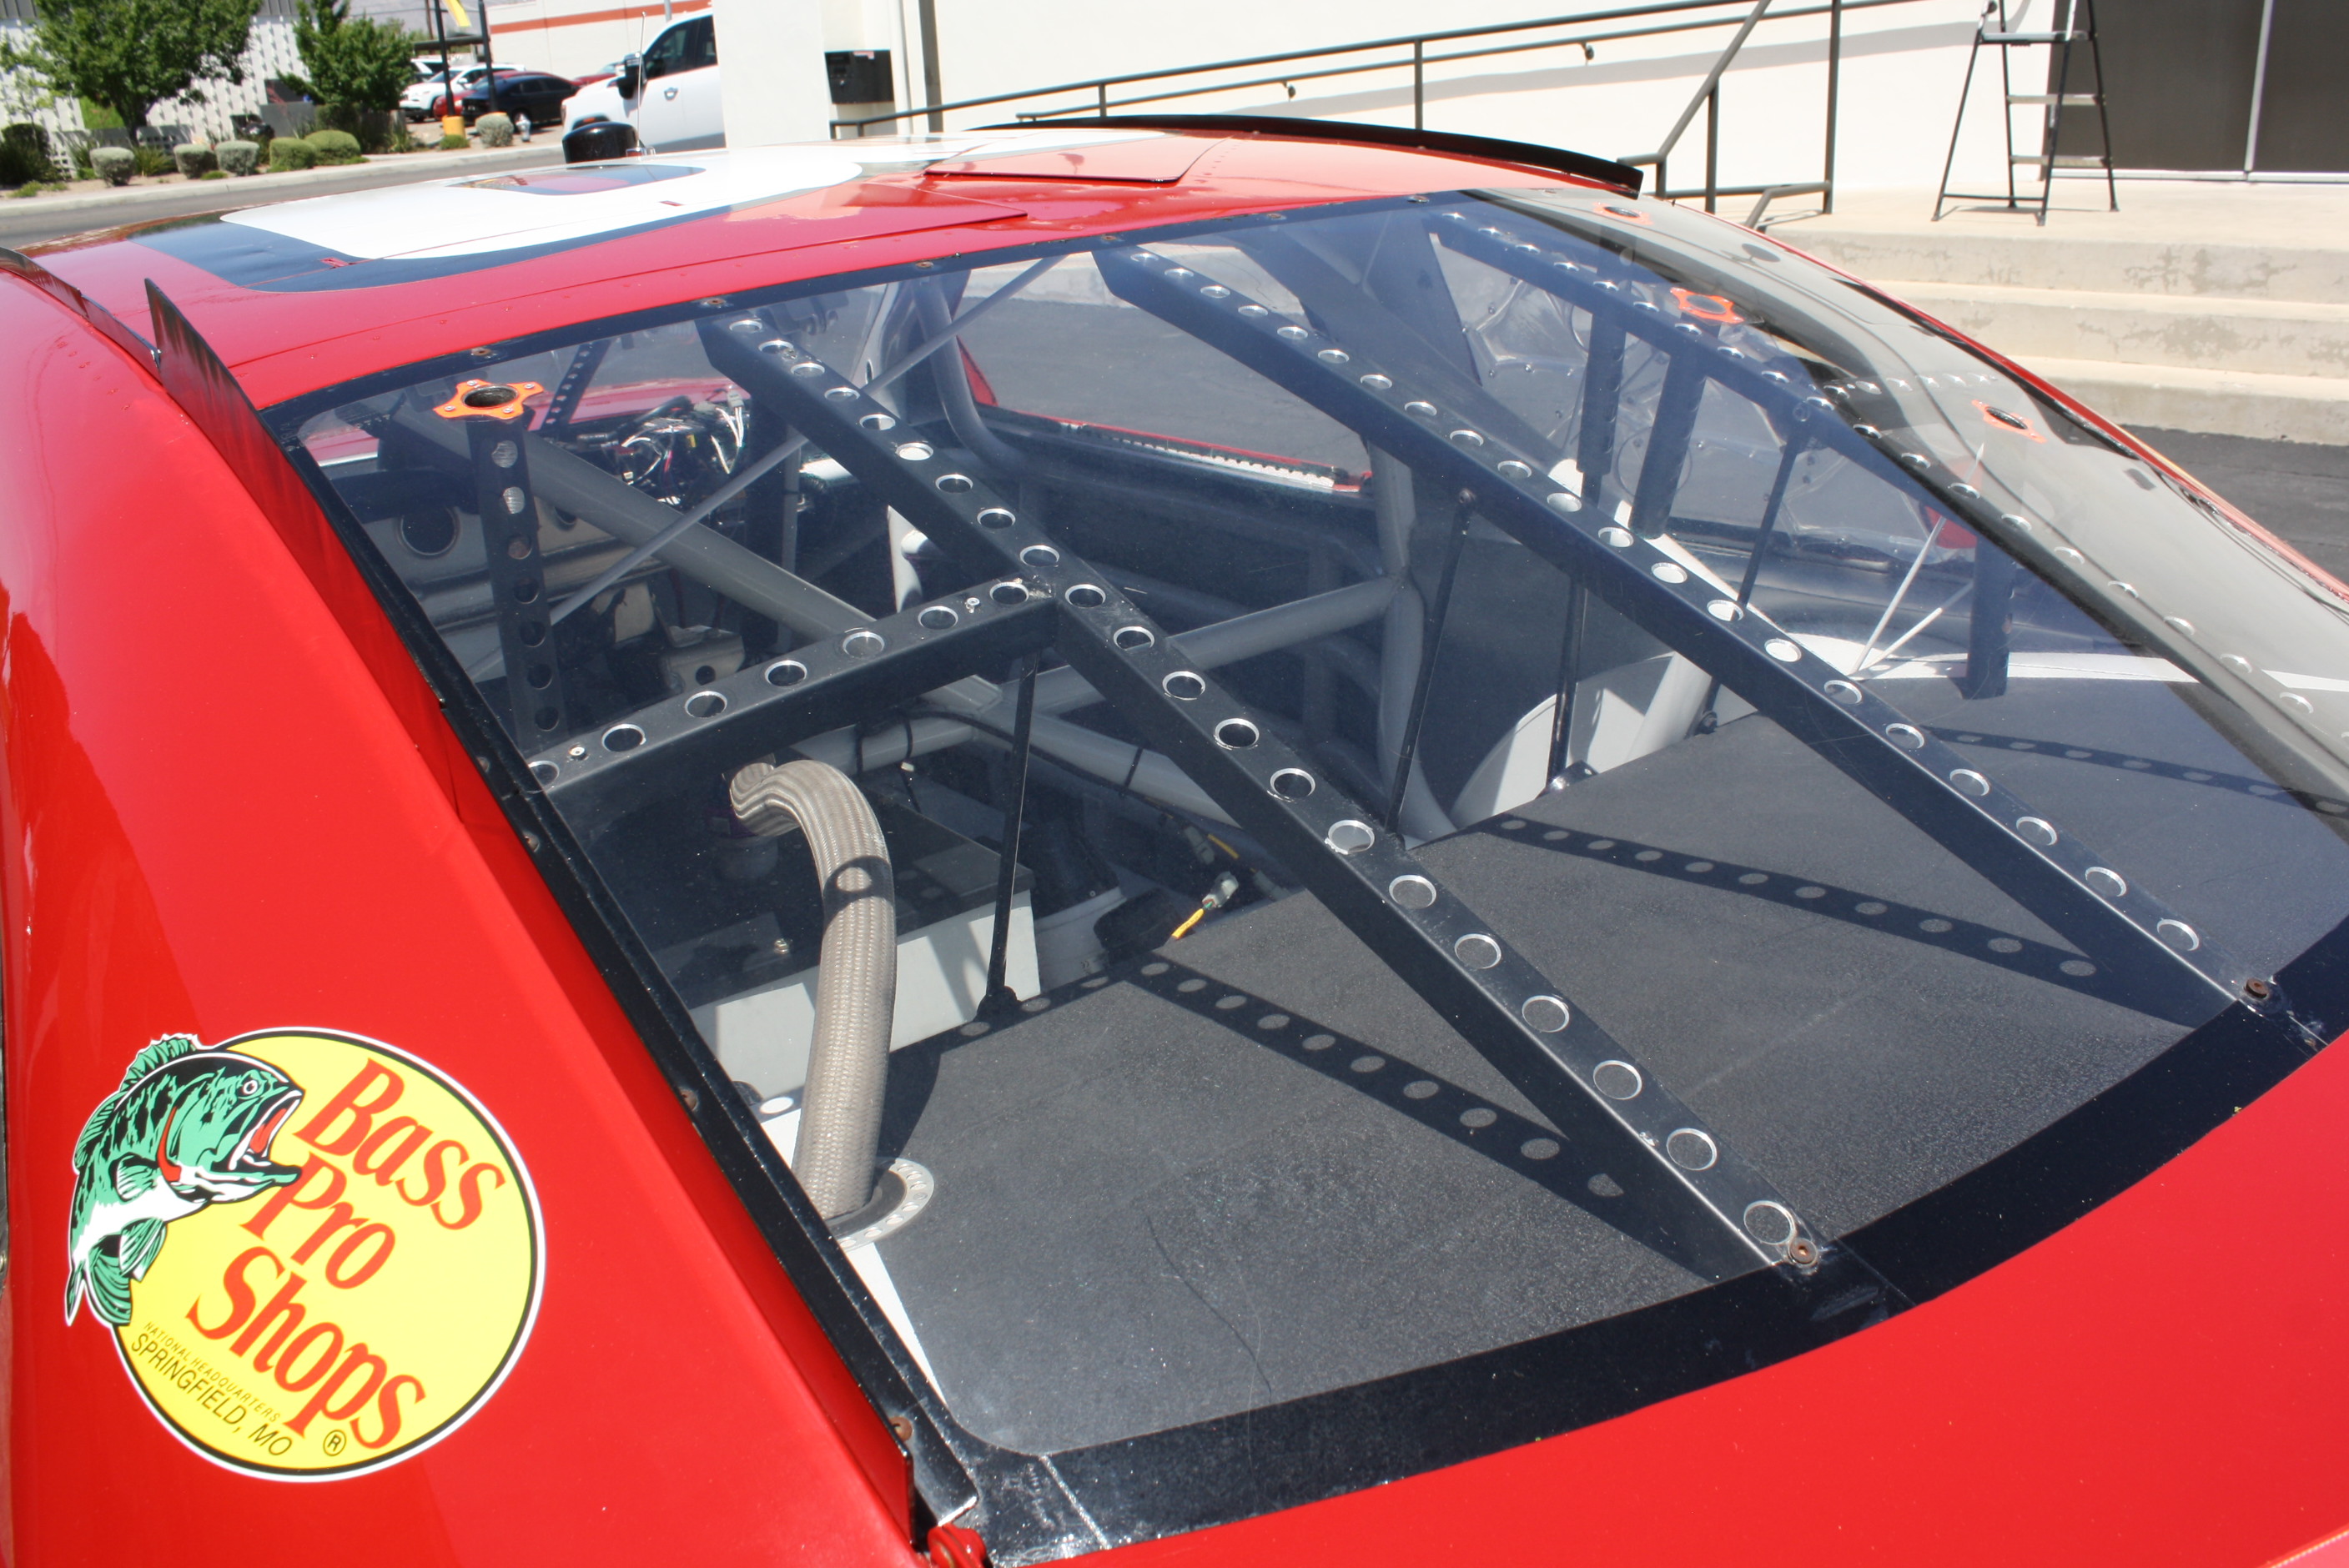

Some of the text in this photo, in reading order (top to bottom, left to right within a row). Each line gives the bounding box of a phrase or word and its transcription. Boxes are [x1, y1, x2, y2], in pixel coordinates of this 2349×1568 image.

[293, 1058, 506, 1230] Bass
[239, 1151, 396, 1289] Pro
[131, 1333, 293, 1456] SPRINGFIELD, MO
[143, 1322, 280, 1422] NATIONAL HEADQUARTERS
[185, 1246, 426, 1450] Shops
